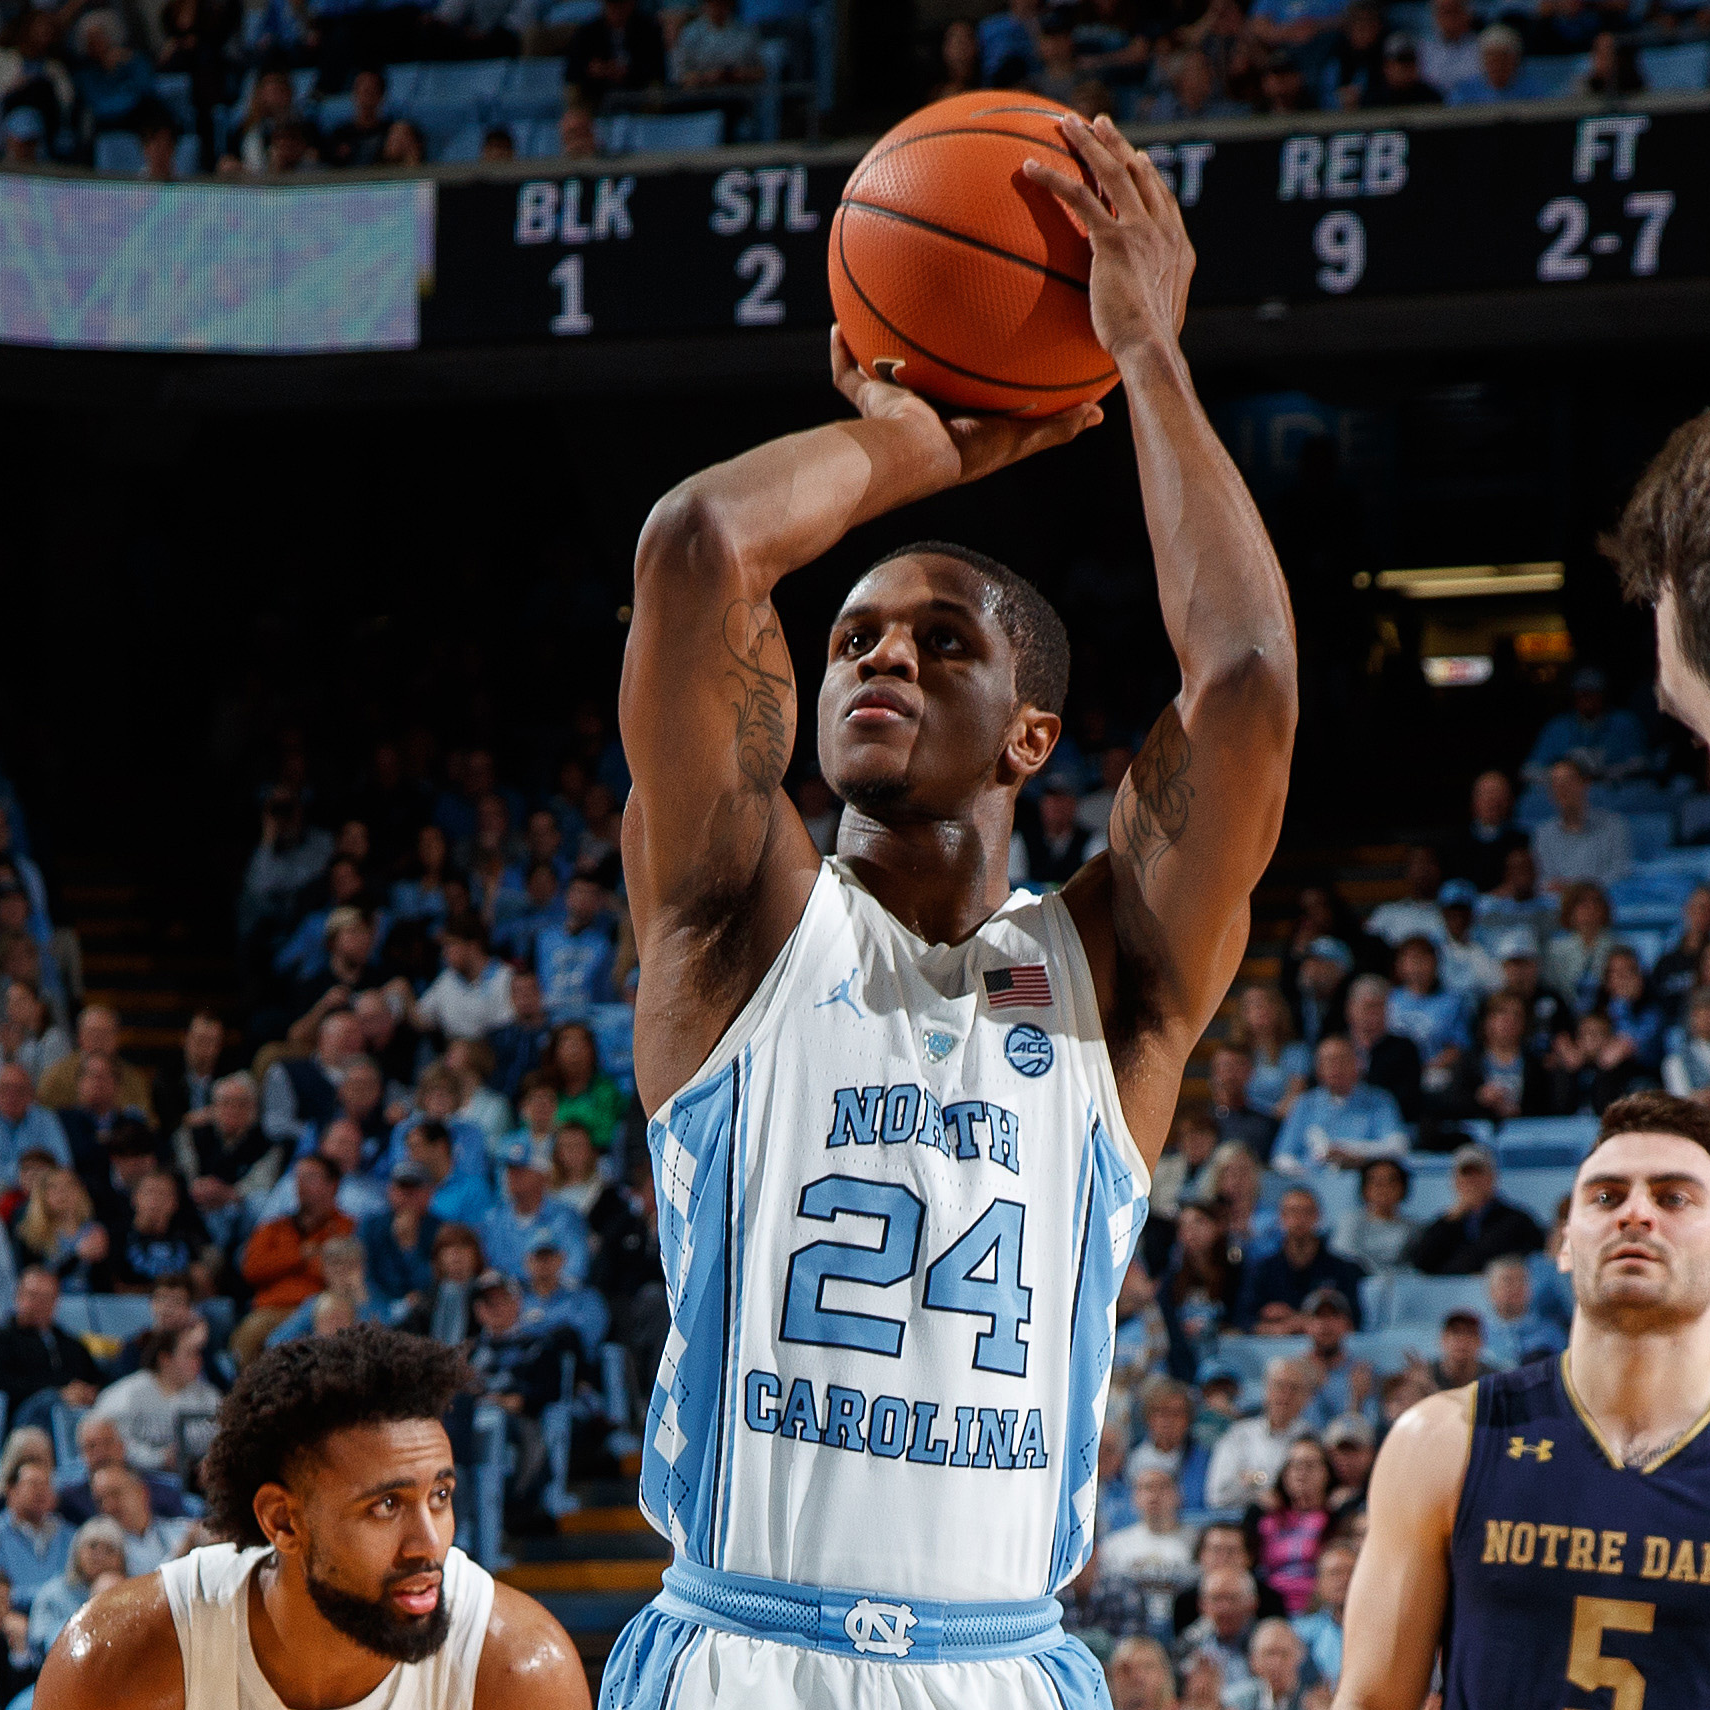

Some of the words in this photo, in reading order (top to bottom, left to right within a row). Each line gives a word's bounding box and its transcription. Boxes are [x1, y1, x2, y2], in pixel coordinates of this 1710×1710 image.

[515, 177, 635, 244] BLK
[711, 167, 819, 235] STL
[1278, 131, 1410, 198] REB
[1574, 116, 1651, 182] FT
[549, 254, 594, 335] 1
[735, 244, 785, 326] 2
[1312, 210, 1367, 294] 9
[1536, 191, 1676, 281] 2-7
[1011, 1041, 1050, 1054] ACC
[827, 1084, 1022, 1176] NORTH
[779, 1173, 1034, 1379] 24
[744, 1368, 1049, 1472] CAROLINA
[1482, 1520, 1627, 1574] NOTRE
